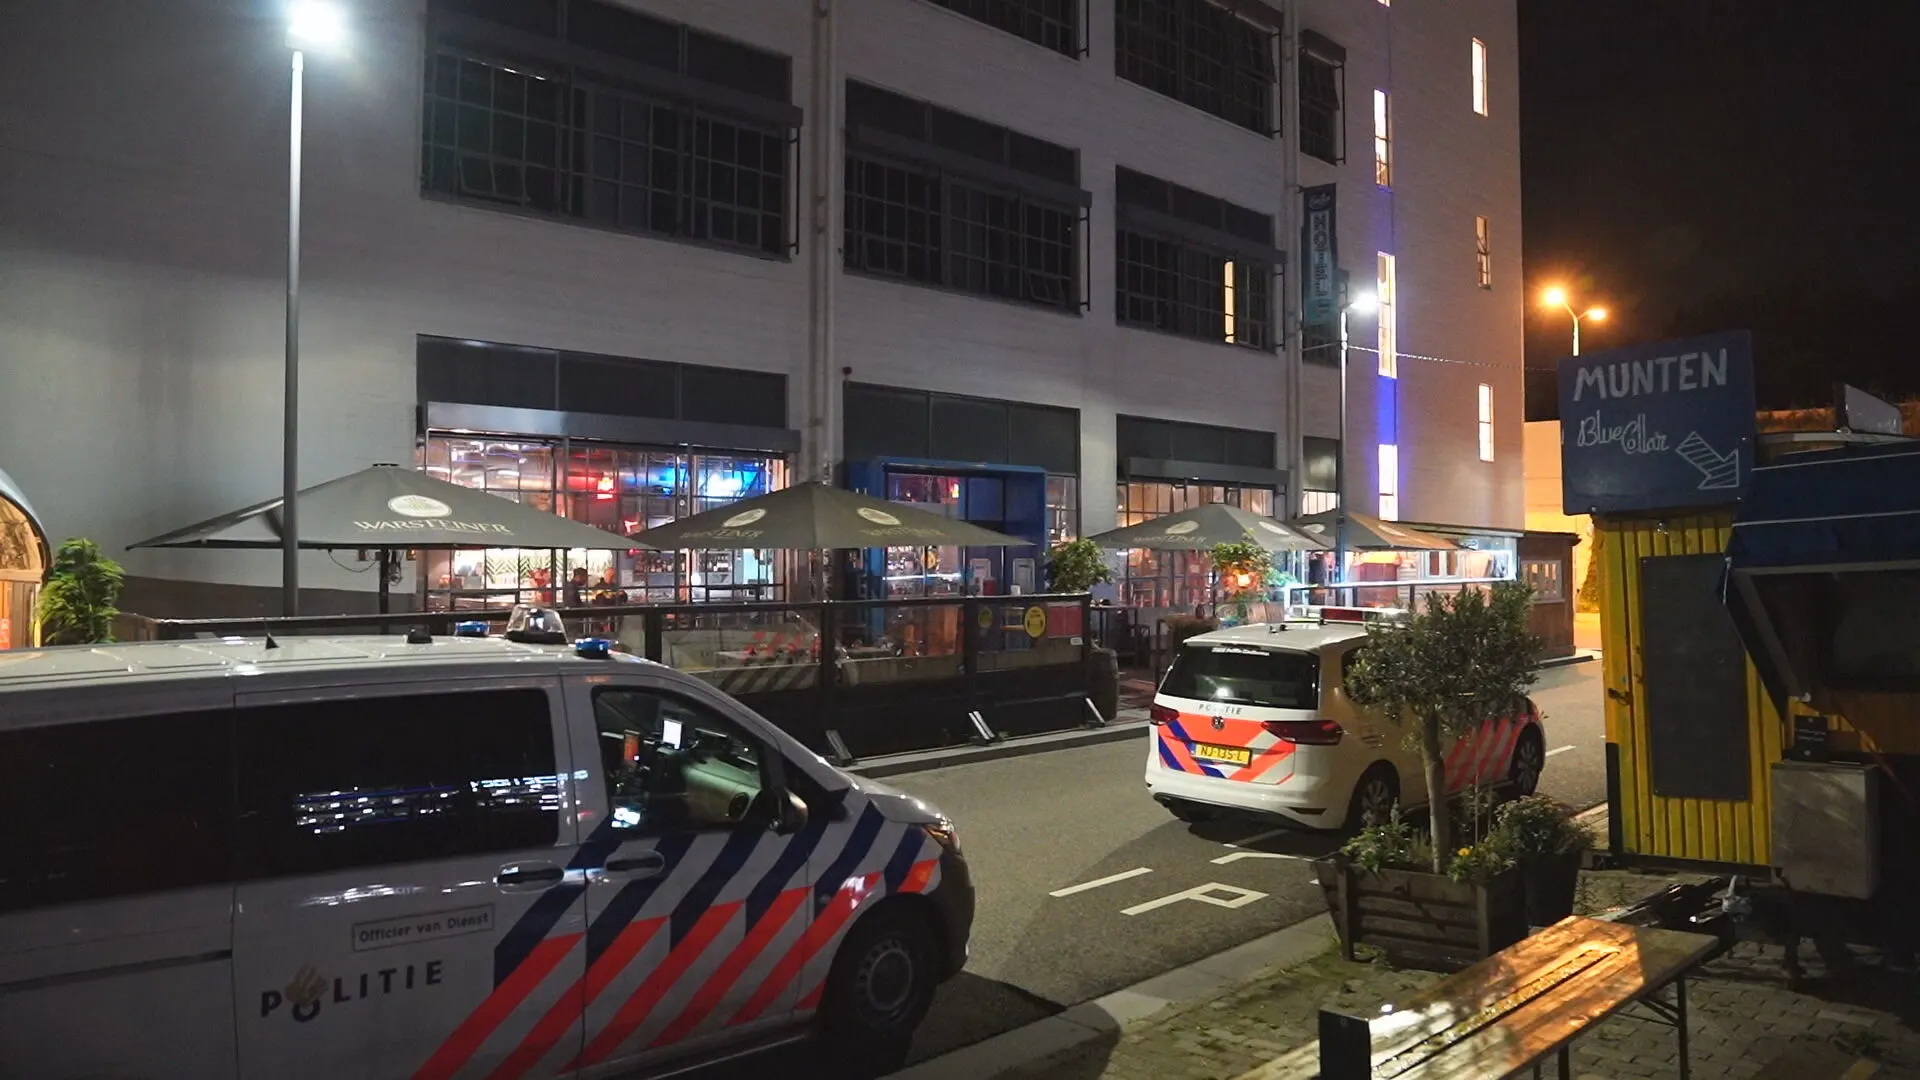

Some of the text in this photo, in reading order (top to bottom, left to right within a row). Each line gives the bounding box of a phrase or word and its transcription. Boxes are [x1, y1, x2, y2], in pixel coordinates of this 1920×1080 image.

[1573, 348, 1728, 401] MUNTEN
[353, 519, 515, 536] WARSTEINER
[1198, 703, 1243, 715] POTIE
[359, 912, 489, 943] Officier van Dienst
[260, 960, 444, 1022] POLITIE
